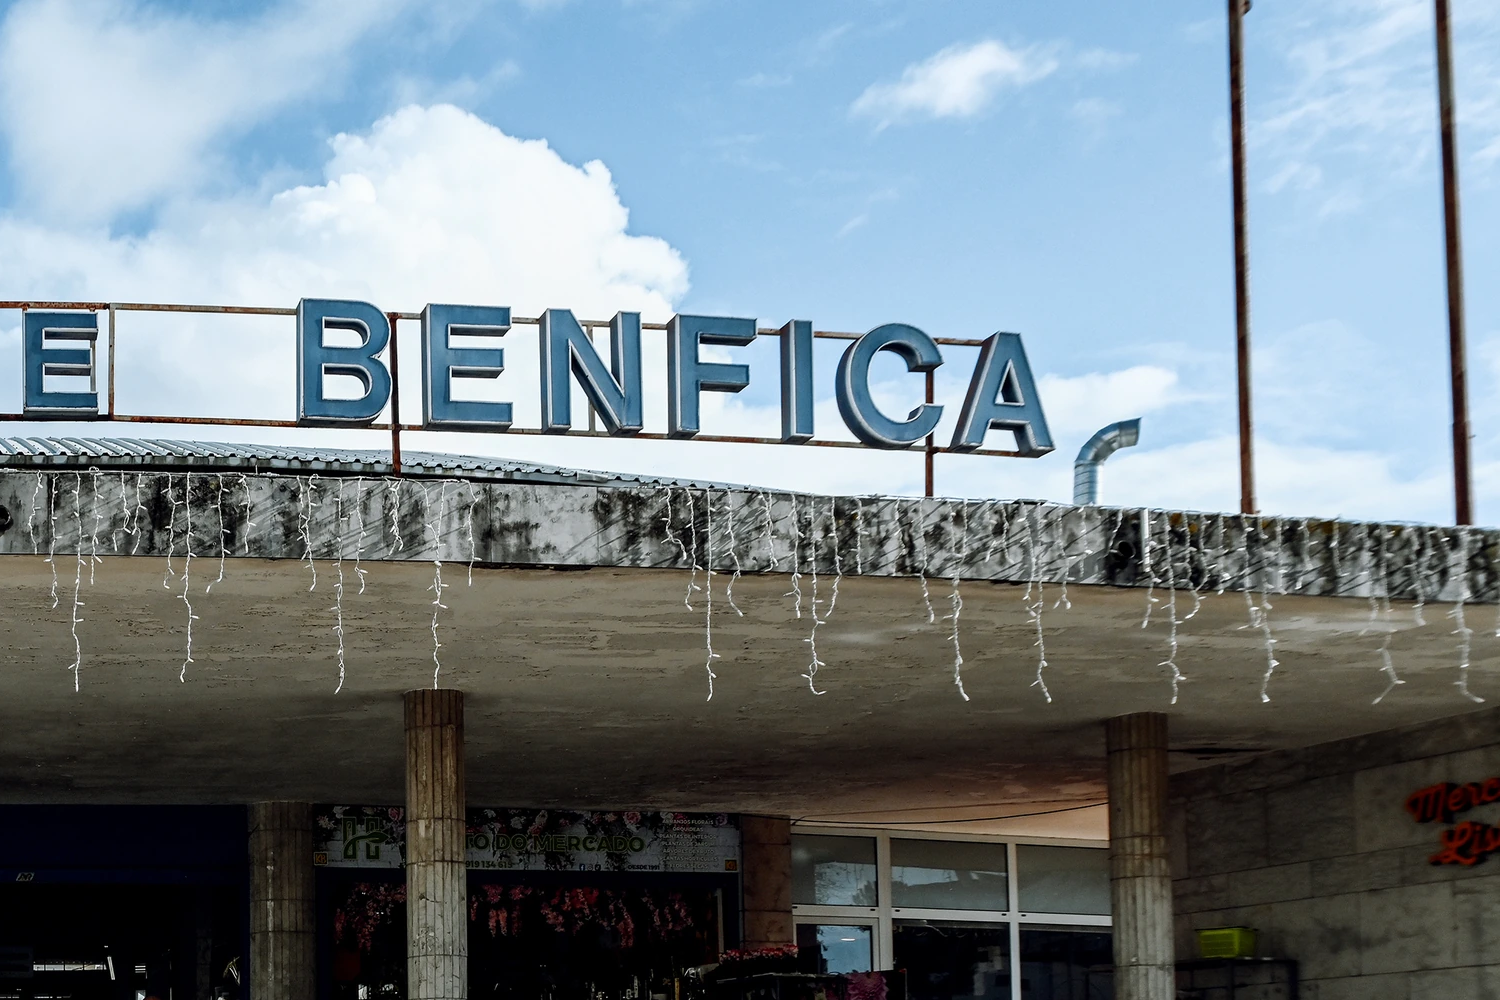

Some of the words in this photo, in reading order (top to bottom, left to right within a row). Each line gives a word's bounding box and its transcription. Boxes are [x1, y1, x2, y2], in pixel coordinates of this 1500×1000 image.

[296, 297, 1056, 457] BENFICA
[496, 834, 527, 851] DO
[533, 835, 644, 852] MERCADO
